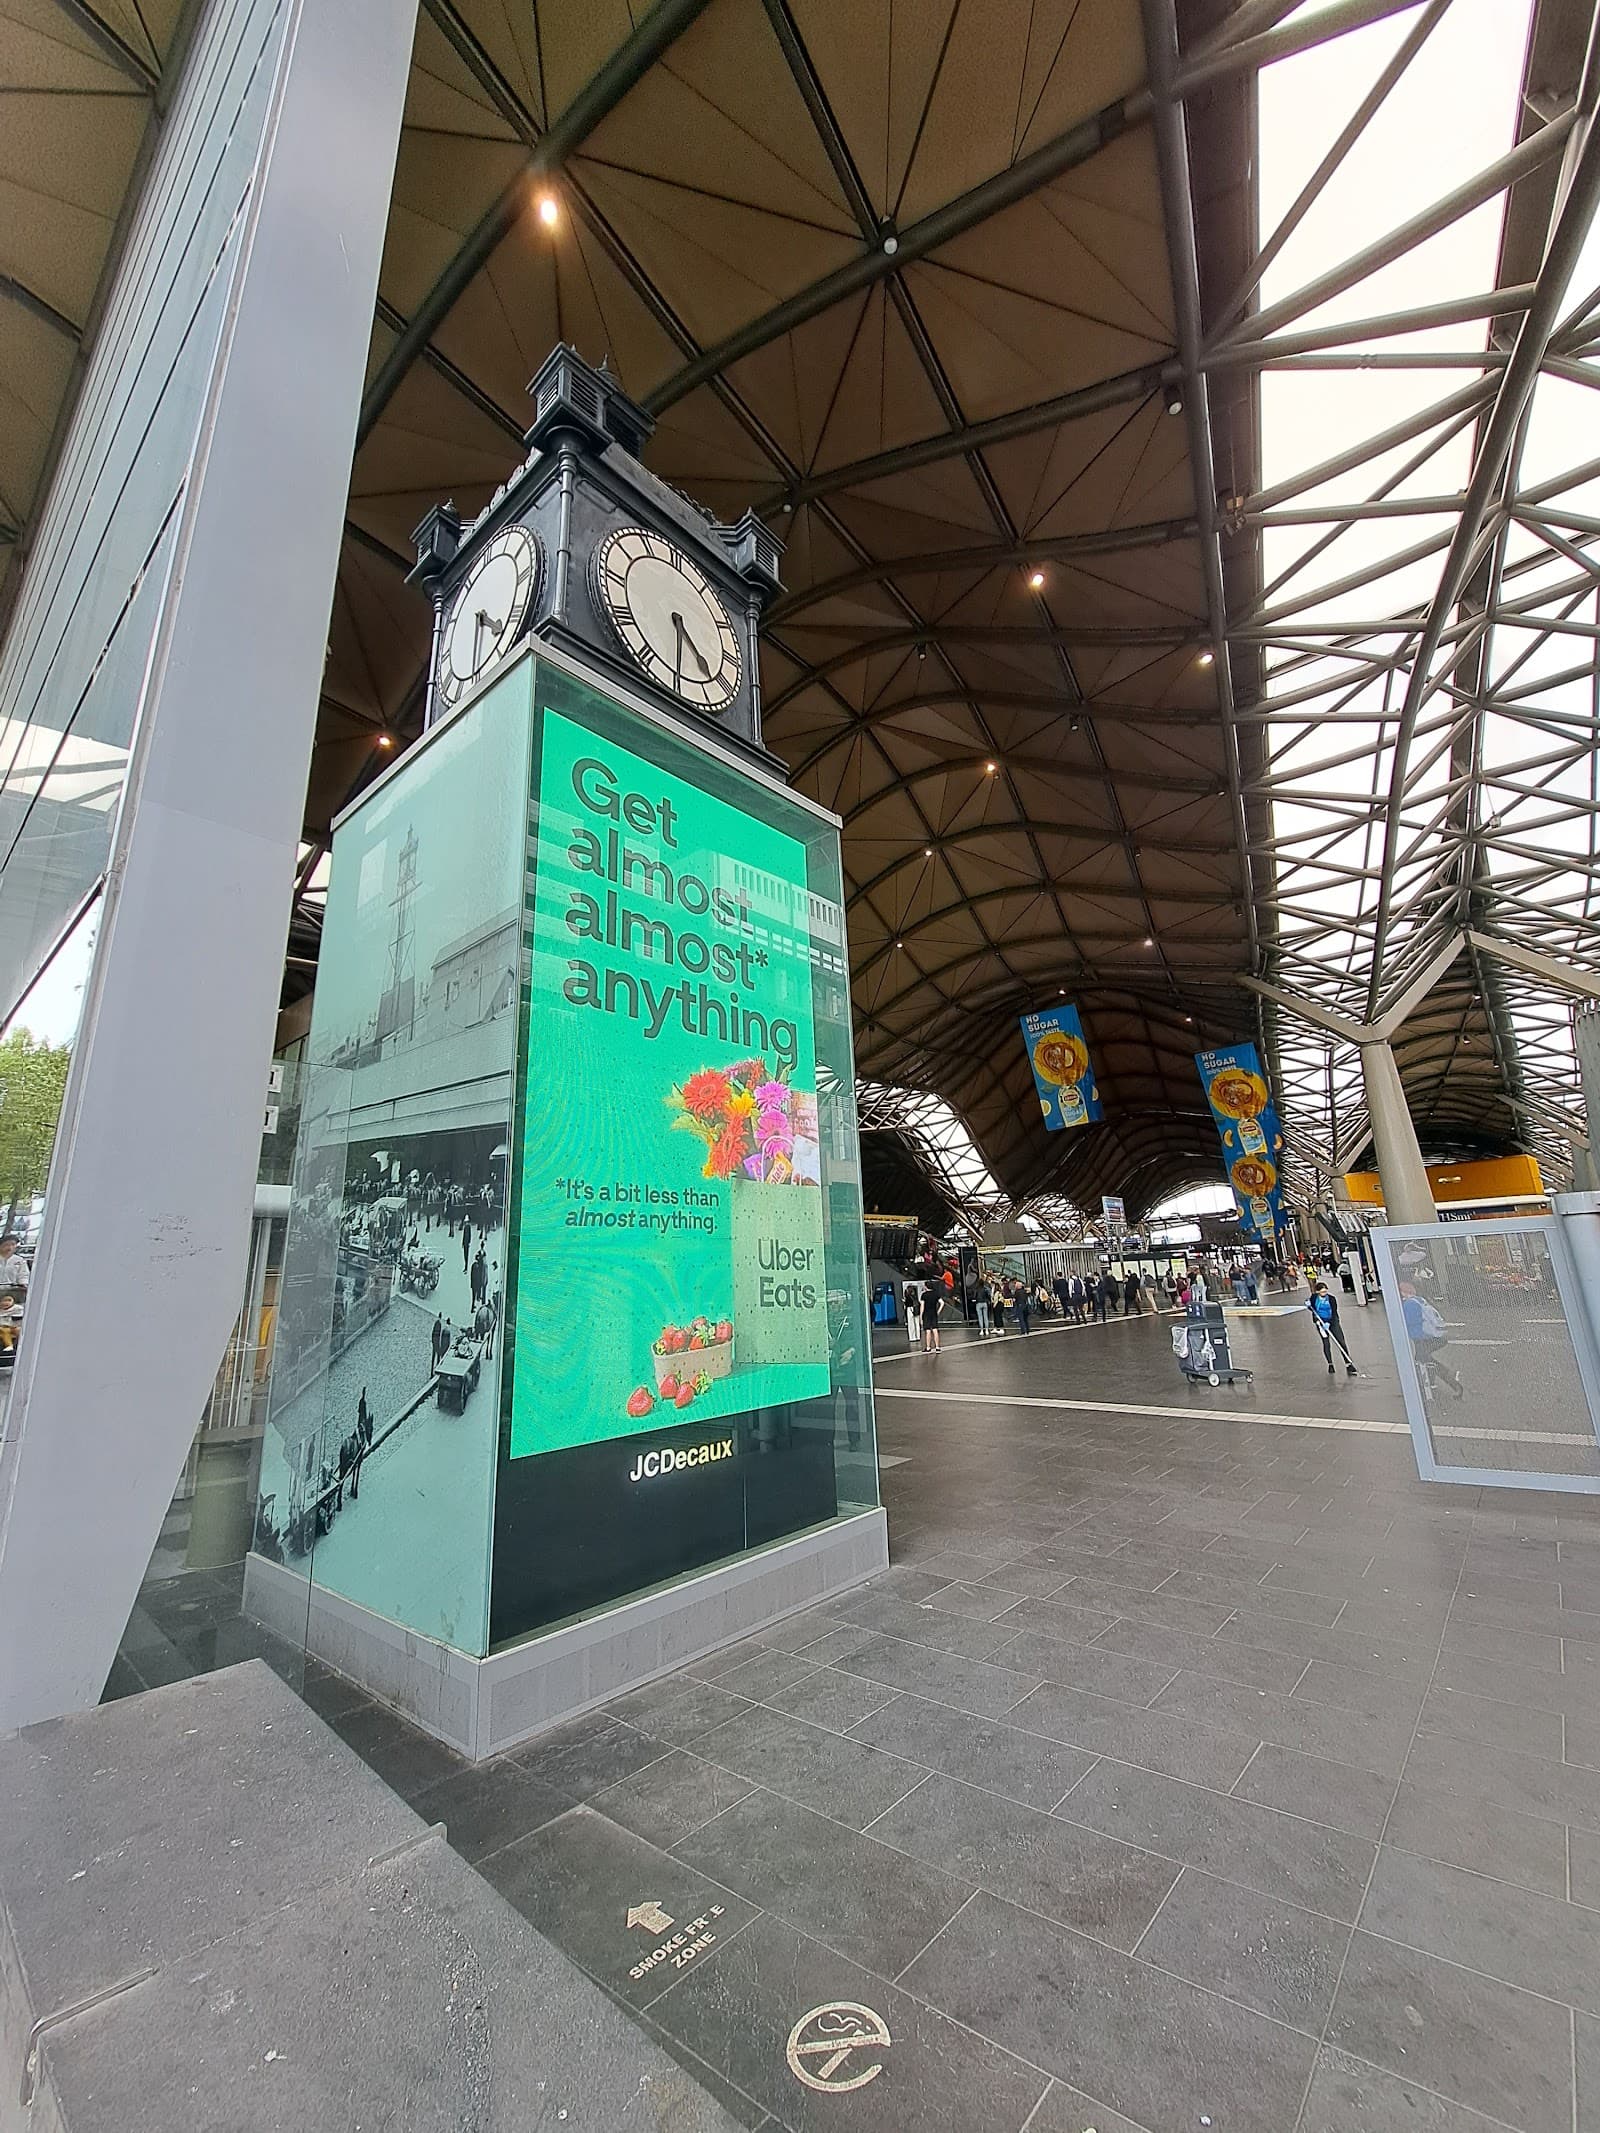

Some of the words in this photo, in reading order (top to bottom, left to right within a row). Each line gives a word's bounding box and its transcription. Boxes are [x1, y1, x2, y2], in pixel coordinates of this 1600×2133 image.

[571, 757, 678, 849] Get
[566, 828, 754, 936] almost
[563, 958, 799, 1072] anything
[1028, 1018, 1059, 1033] SUGAR
[1203, 1056, 1237, 1069] SUGAR
[599, 1185, 612, 1201] a
[615, 1182, 641, 1203] bit
[645, 1184, 680, 1205] less
[683, 1187, 720, 1207] than
[564, 1206, 637, 1228] almost
[638, 1210, 719, 1235] anything.
[758, 1238, 814, 1271] Uber
[759, 1276, 817, 1309] Eats
[629, 1439, 734, 1483] JCDecaux
[628, 1931, 689, 1980] SMOKE
[670, 1930, 718, 1970] ZONE
